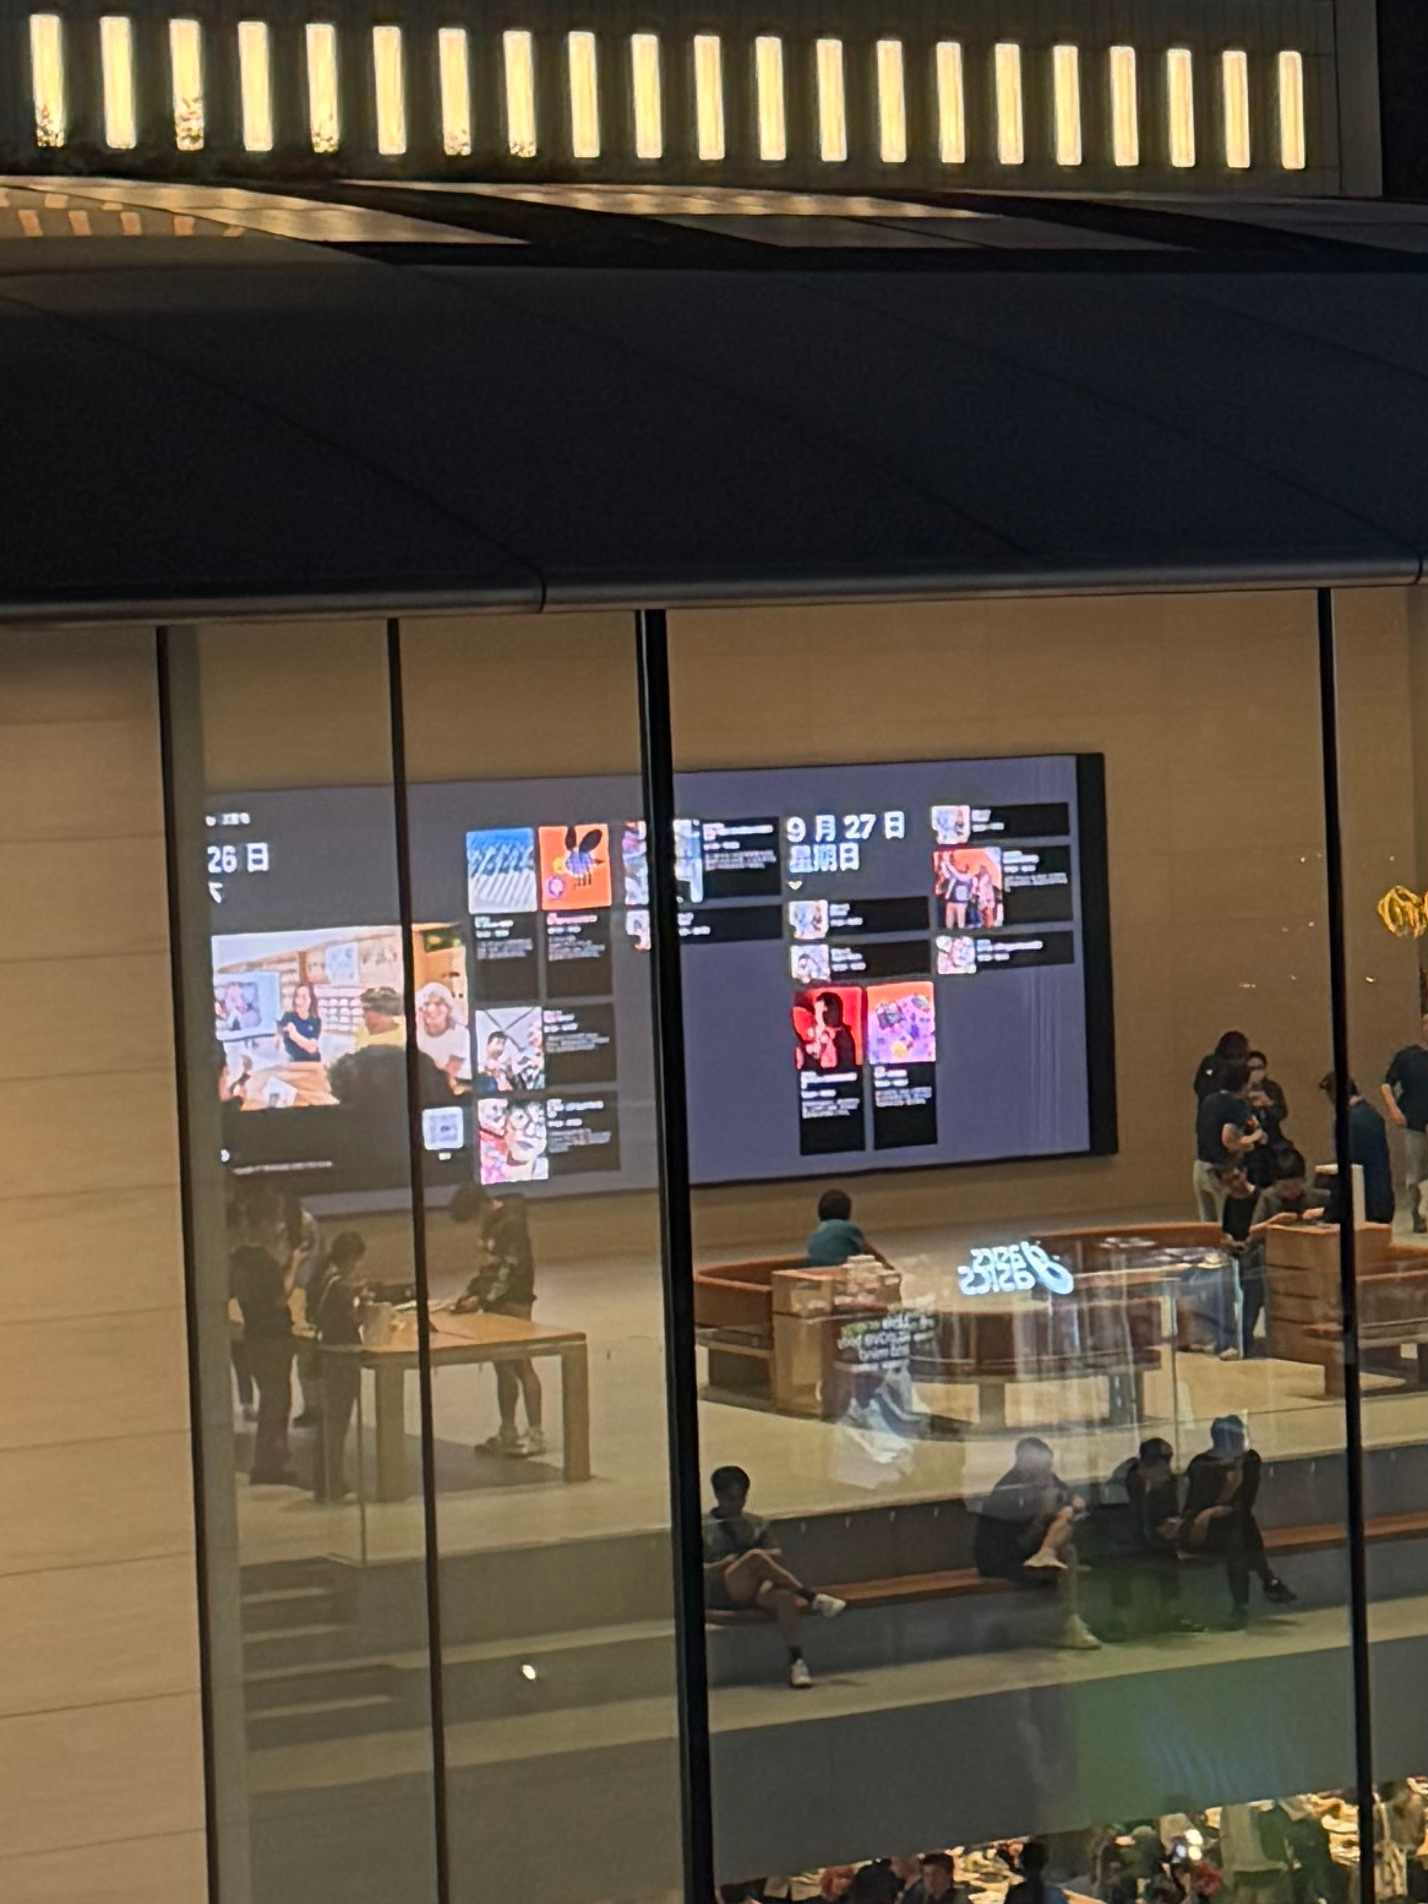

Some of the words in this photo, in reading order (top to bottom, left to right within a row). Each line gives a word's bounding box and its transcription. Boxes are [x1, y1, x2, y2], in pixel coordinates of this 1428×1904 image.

[787, 816, 806, 842] 9
[815, 814, 836, 842] 月
[843, 813, 876, 840] 27
[884, 810, 905, 840] 日
[207, 844, 237, 873] 26
[245, 842, 270, 873] 日
[789, 841, 860, 873] 星期日
